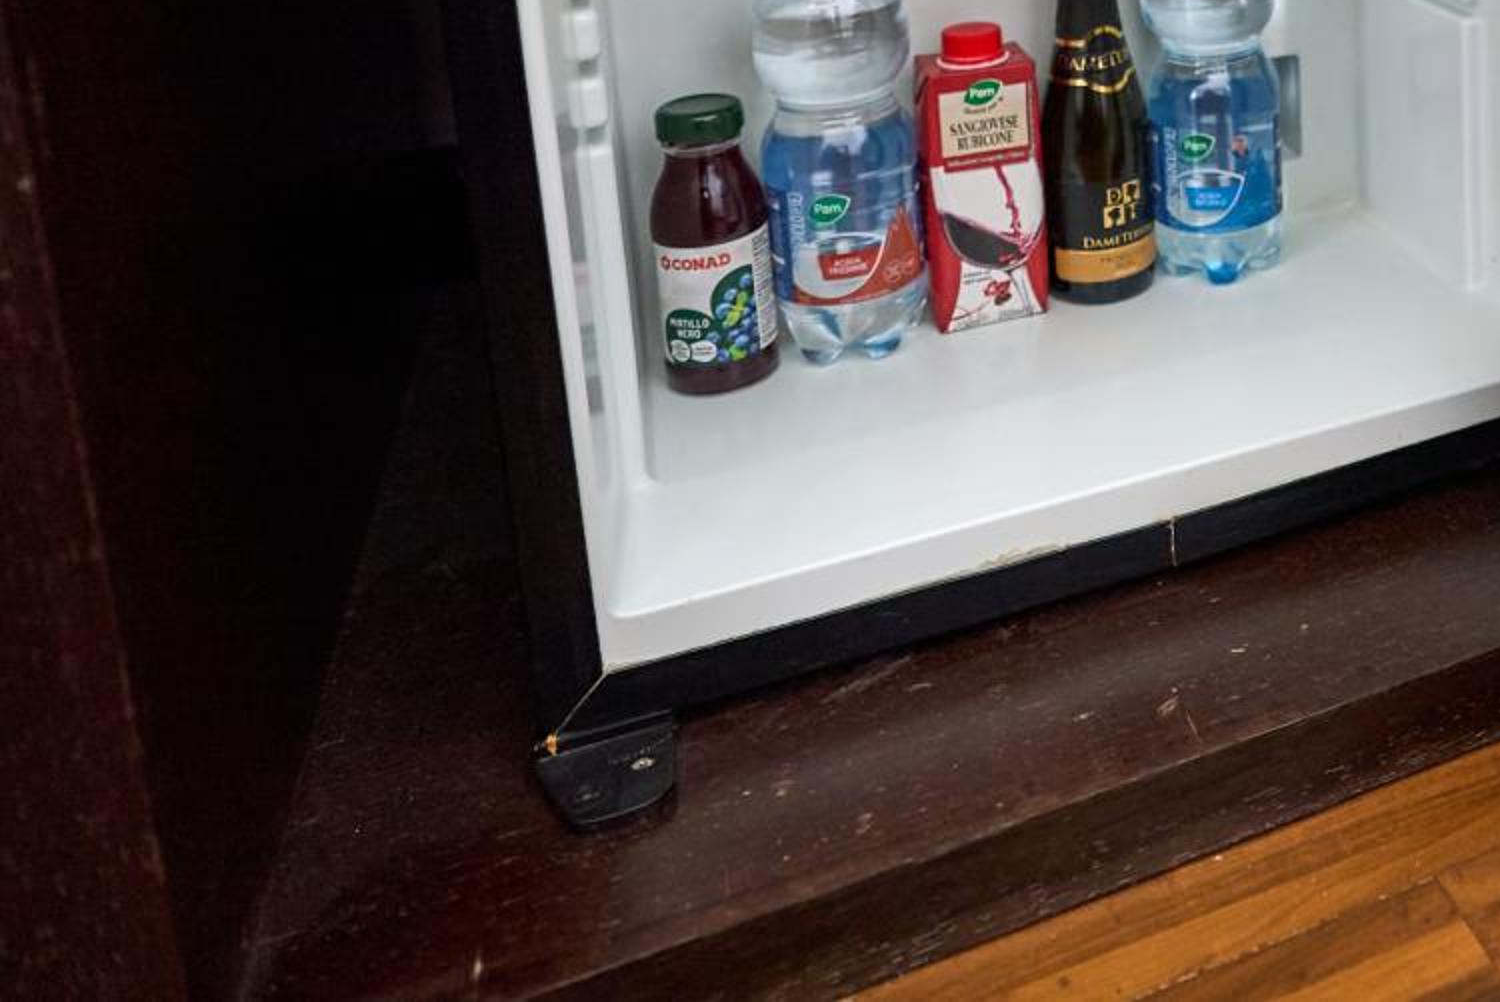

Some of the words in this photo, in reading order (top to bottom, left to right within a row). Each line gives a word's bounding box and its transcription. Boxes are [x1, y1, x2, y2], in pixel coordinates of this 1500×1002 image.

[950, 114, 1019, 135] SANGIOVESE
[957, 129, 1014, 150] RUBICONE
[814, 203, 841, 214] Pam
[671, 253, 731, 270] CONAD
